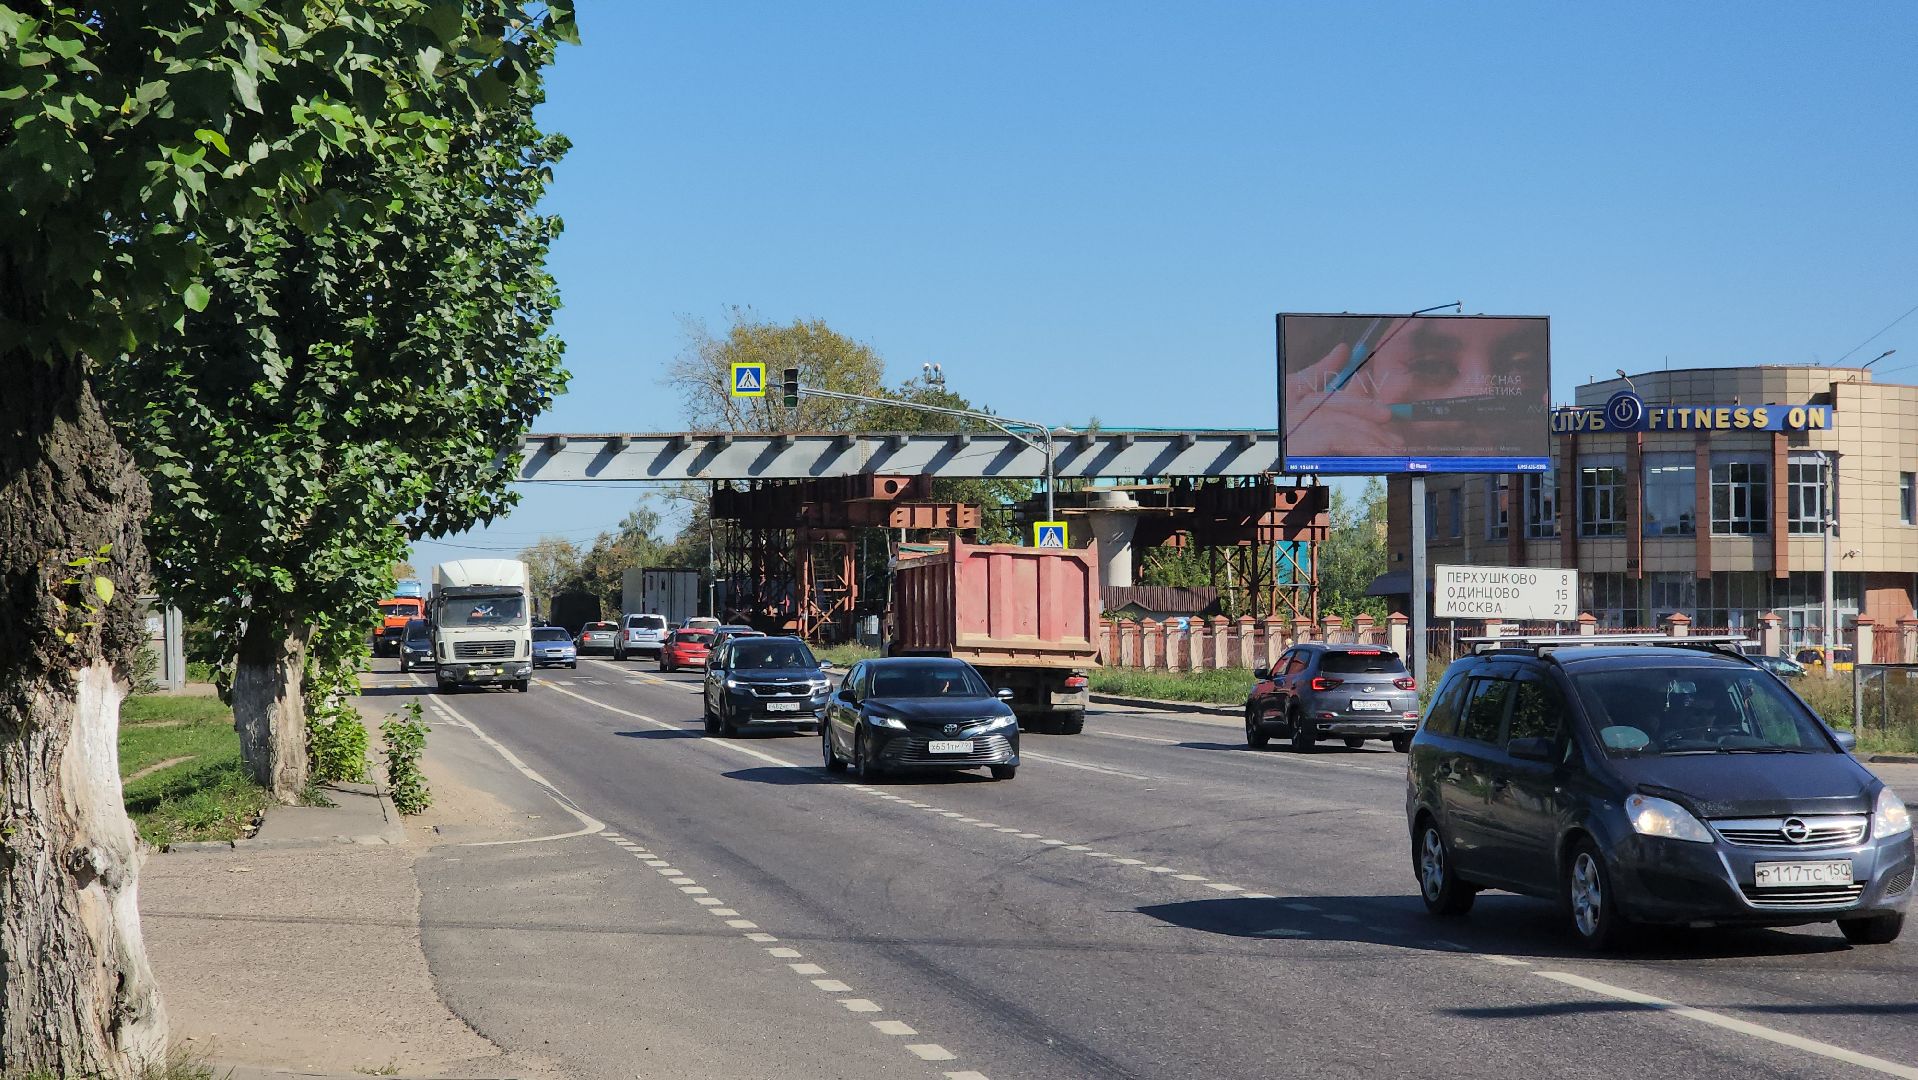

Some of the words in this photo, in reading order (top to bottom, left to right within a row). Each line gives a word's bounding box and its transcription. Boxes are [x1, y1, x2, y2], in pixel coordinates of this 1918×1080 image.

[1648, 407, 1769, 429] FITNESS
[1788, 407, 1825, 429] ON
[1447, 571, 1537, 585] ПЕРХУШКОВО
[1561, 574, 1568, 586] 8
[1447, 586, 1520, 600] ОДИНЦОВО
[1556, 589, 1568, 600] 15
[1446, 601, 1503, 613] МОСКВА
[1553, 604, 1568, 615] 27
